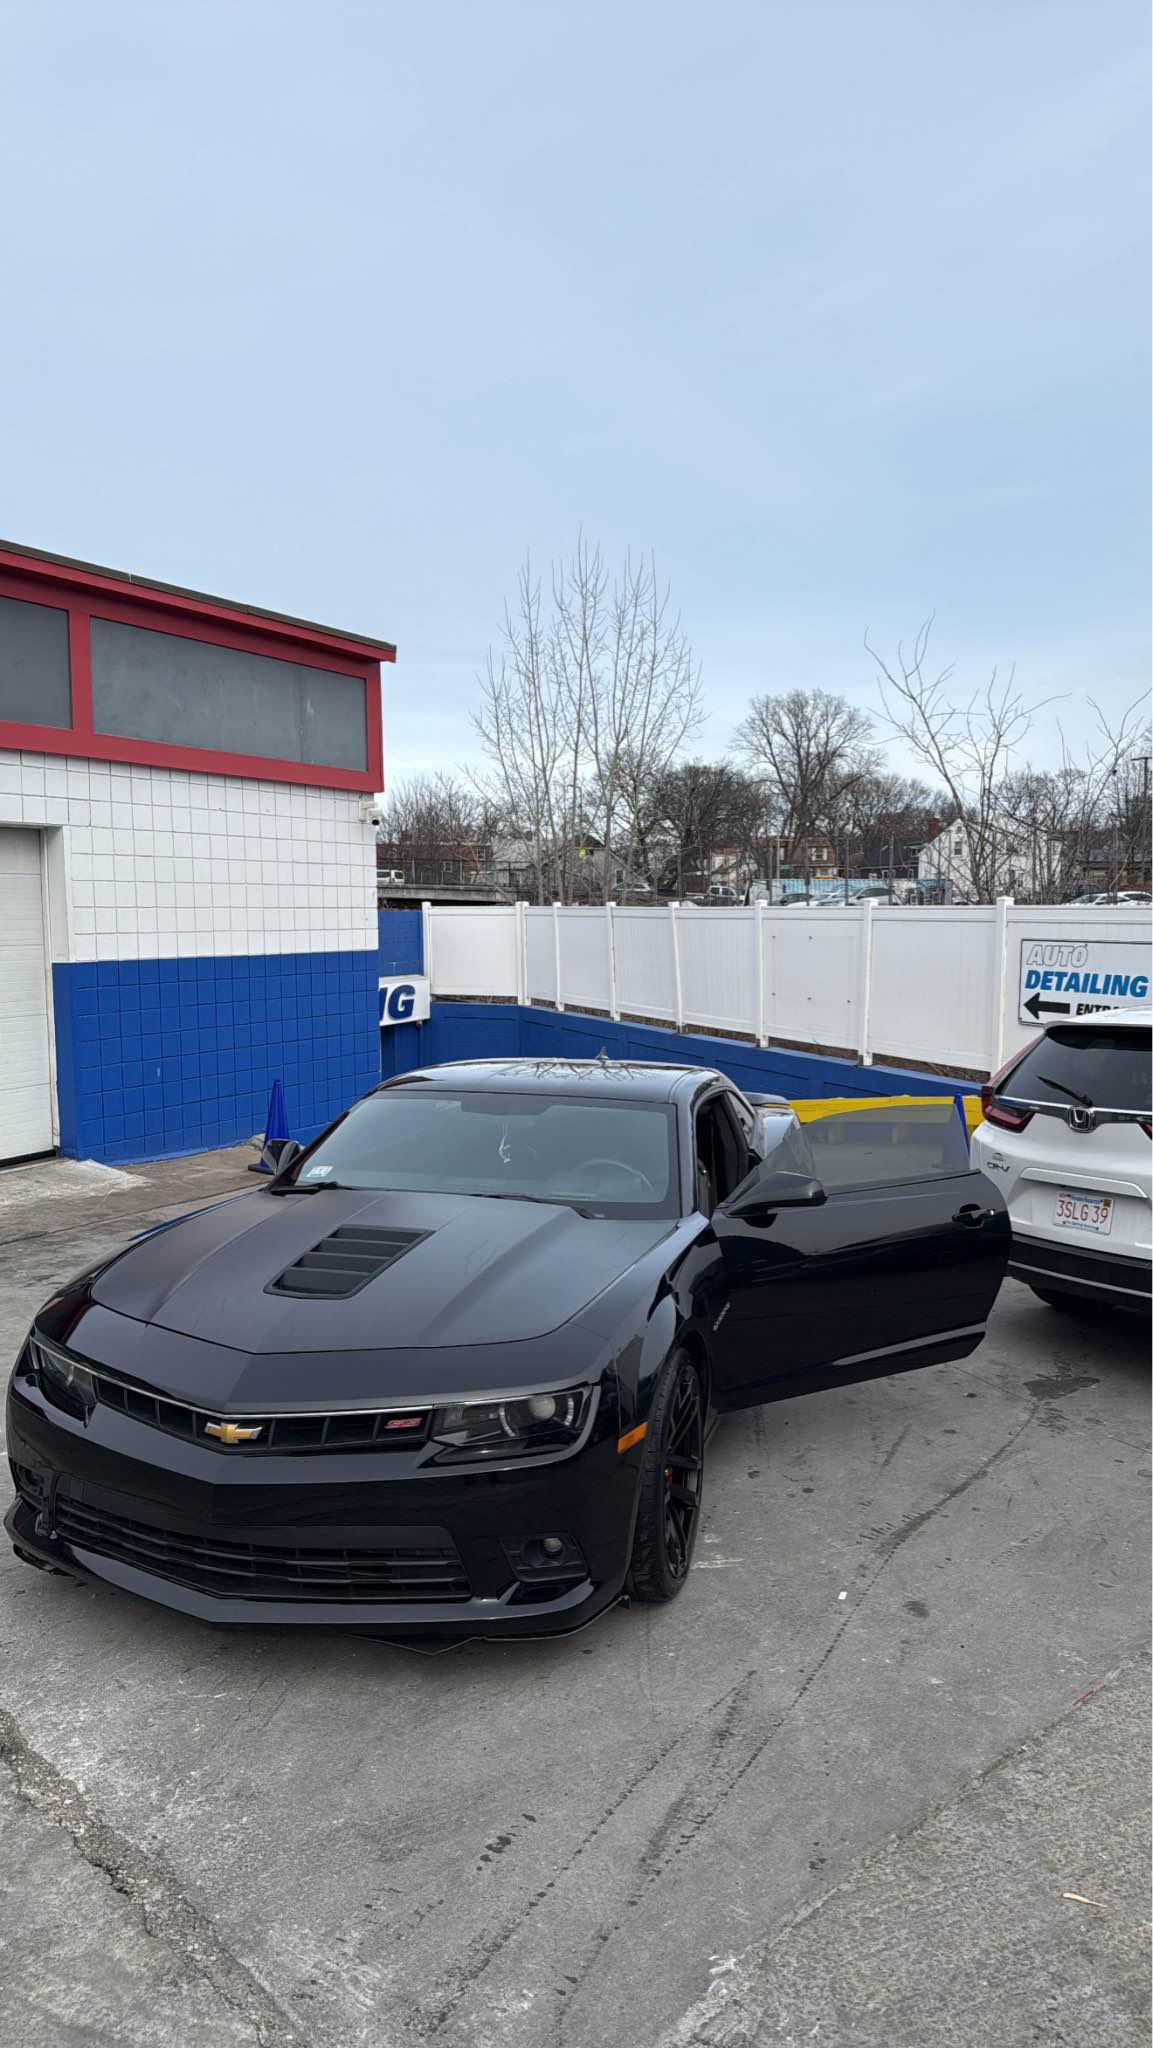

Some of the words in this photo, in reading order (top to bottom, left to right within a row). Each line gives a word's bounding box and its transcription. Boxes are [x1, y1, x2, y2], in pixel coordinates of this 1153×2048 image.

[1026, 944, 1089, 968] AUTO
[1025, 970, 1149, 998] DETAILING
[1056, 1199, 1089, 1221] 3SLG
[1091, 1205, 1109, 1224] 39
